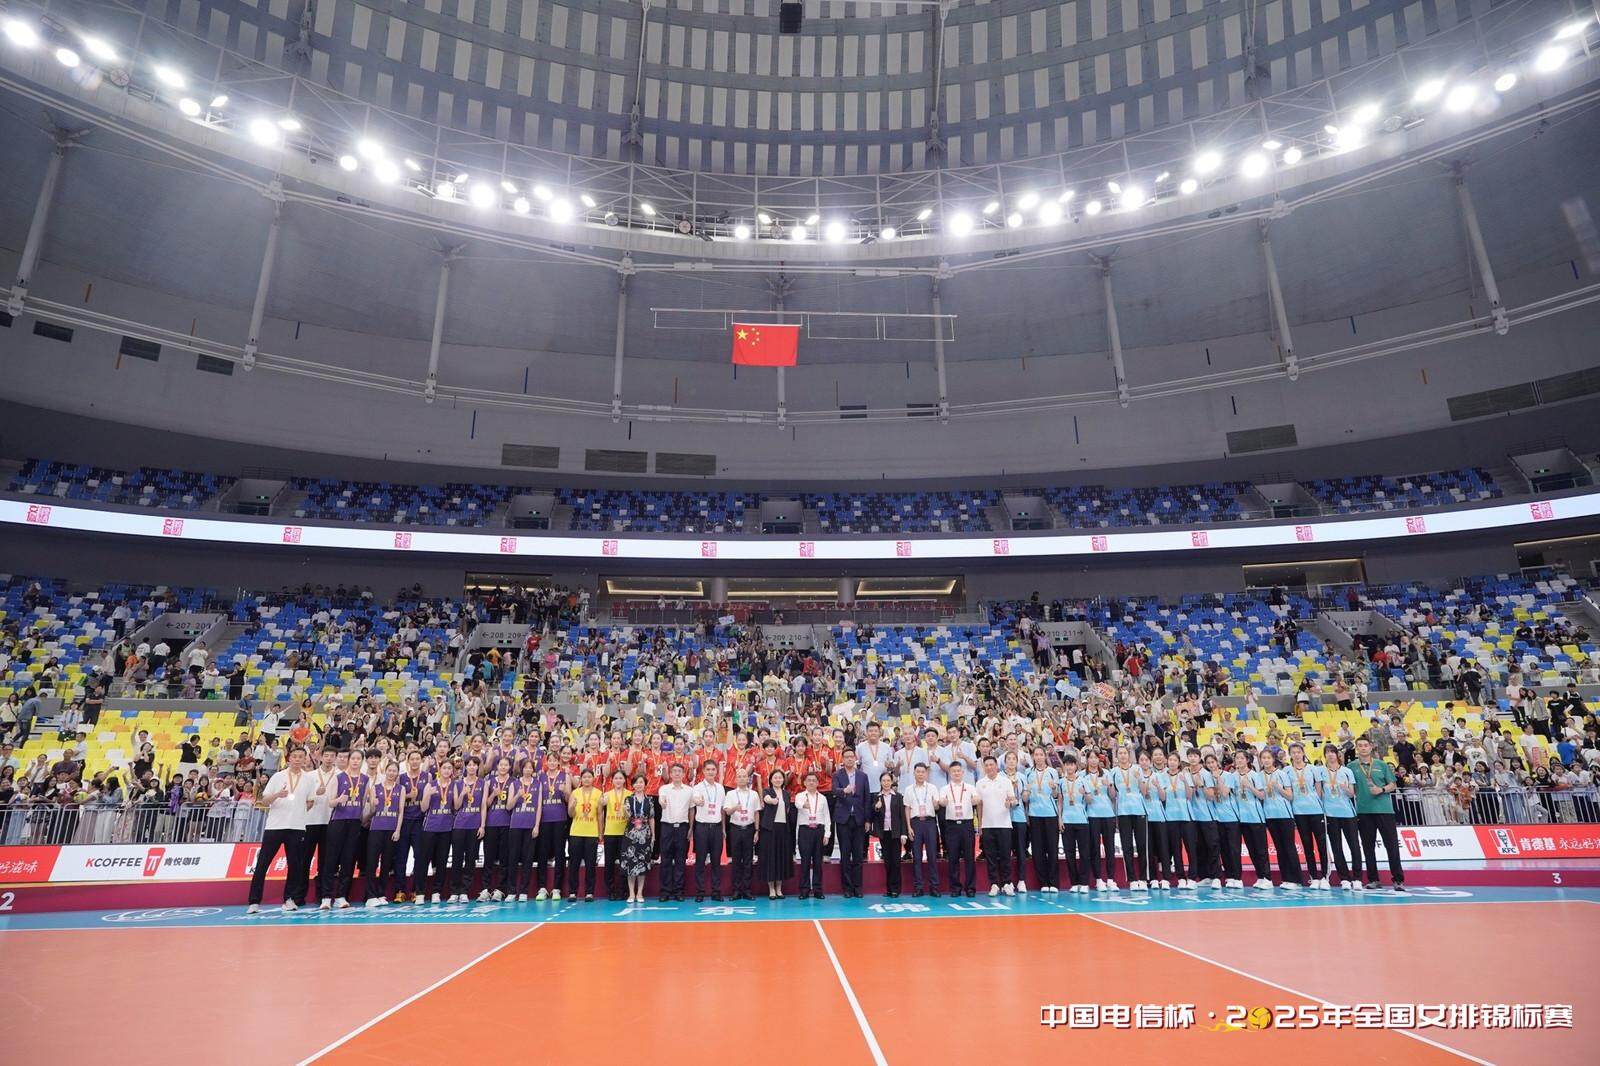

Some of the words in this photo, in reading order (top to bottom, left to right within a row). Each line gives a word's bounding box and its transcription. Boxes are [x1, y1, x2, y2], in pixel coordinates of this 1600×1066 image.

[1421, 837, 1454, 848] 肯悦咖啡
[1520, 837, 1556, 851] 肯德基
[86, 857, 143, 868] KCOFFEE
[163, 856, 201, 867] 肯悦咖啡
[1552, 873, 1562, 884] 3
